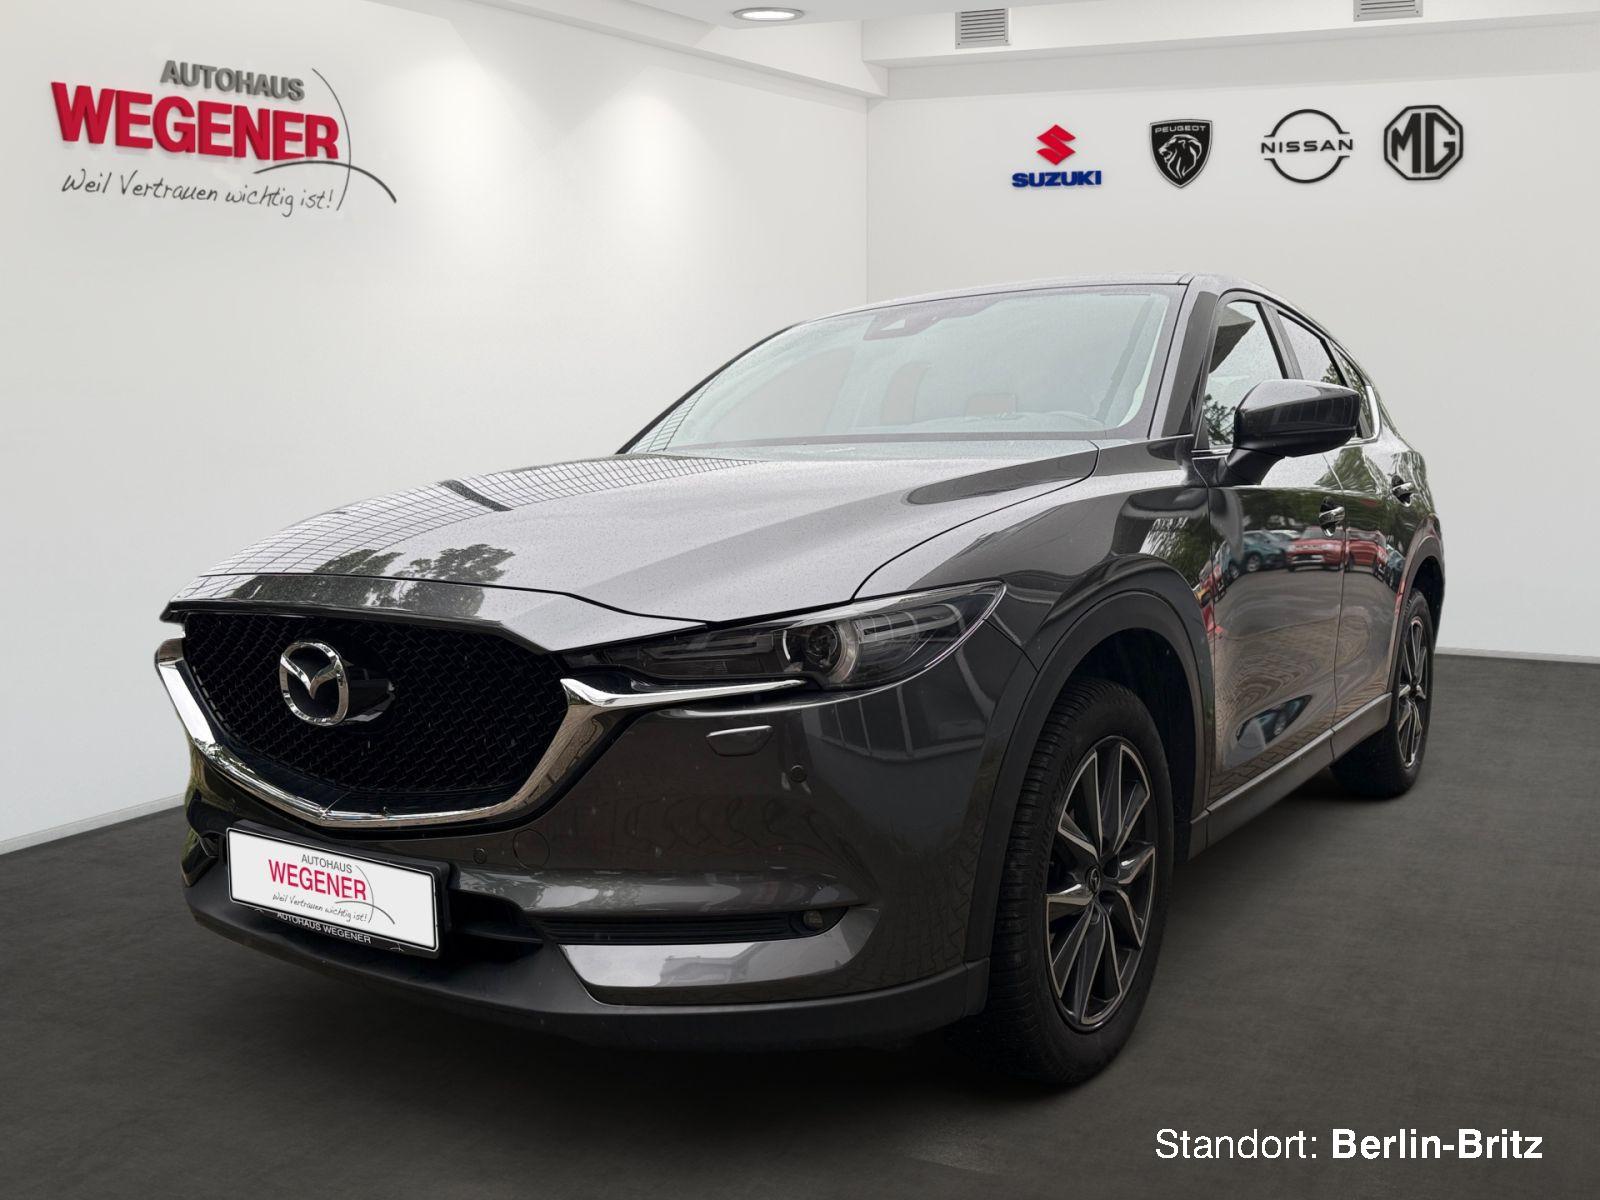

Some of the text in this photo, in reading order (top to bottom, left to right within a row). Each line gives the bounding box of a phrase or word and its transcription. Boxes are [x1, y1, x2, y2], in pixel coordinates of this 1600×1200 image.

[160, 60, 305, 101] AUTOHAUS
[51, 81, 339, 161] WEGENER
[1154, 124, 1207, 133] PEUGEOT
[1260, 138, 1353, 154] NISSAN
[1391, 112, 1456, 174] MG
[61, 168, 333, 218] Weil Vertrauen wichtig ist!
[1011, 170, 1103, 188] SUZUKI
[268, 859, 367, 901] WEGENER
[301, 854, 353, 874] AUTOHAUS
[272, 891, 288, 903] Weil
[289, 895, 323, 912] Vertrauen
[324, 905, 352, 922] wichtig
[276, 911, 372, 944] AUTOHAUS WEGENER
